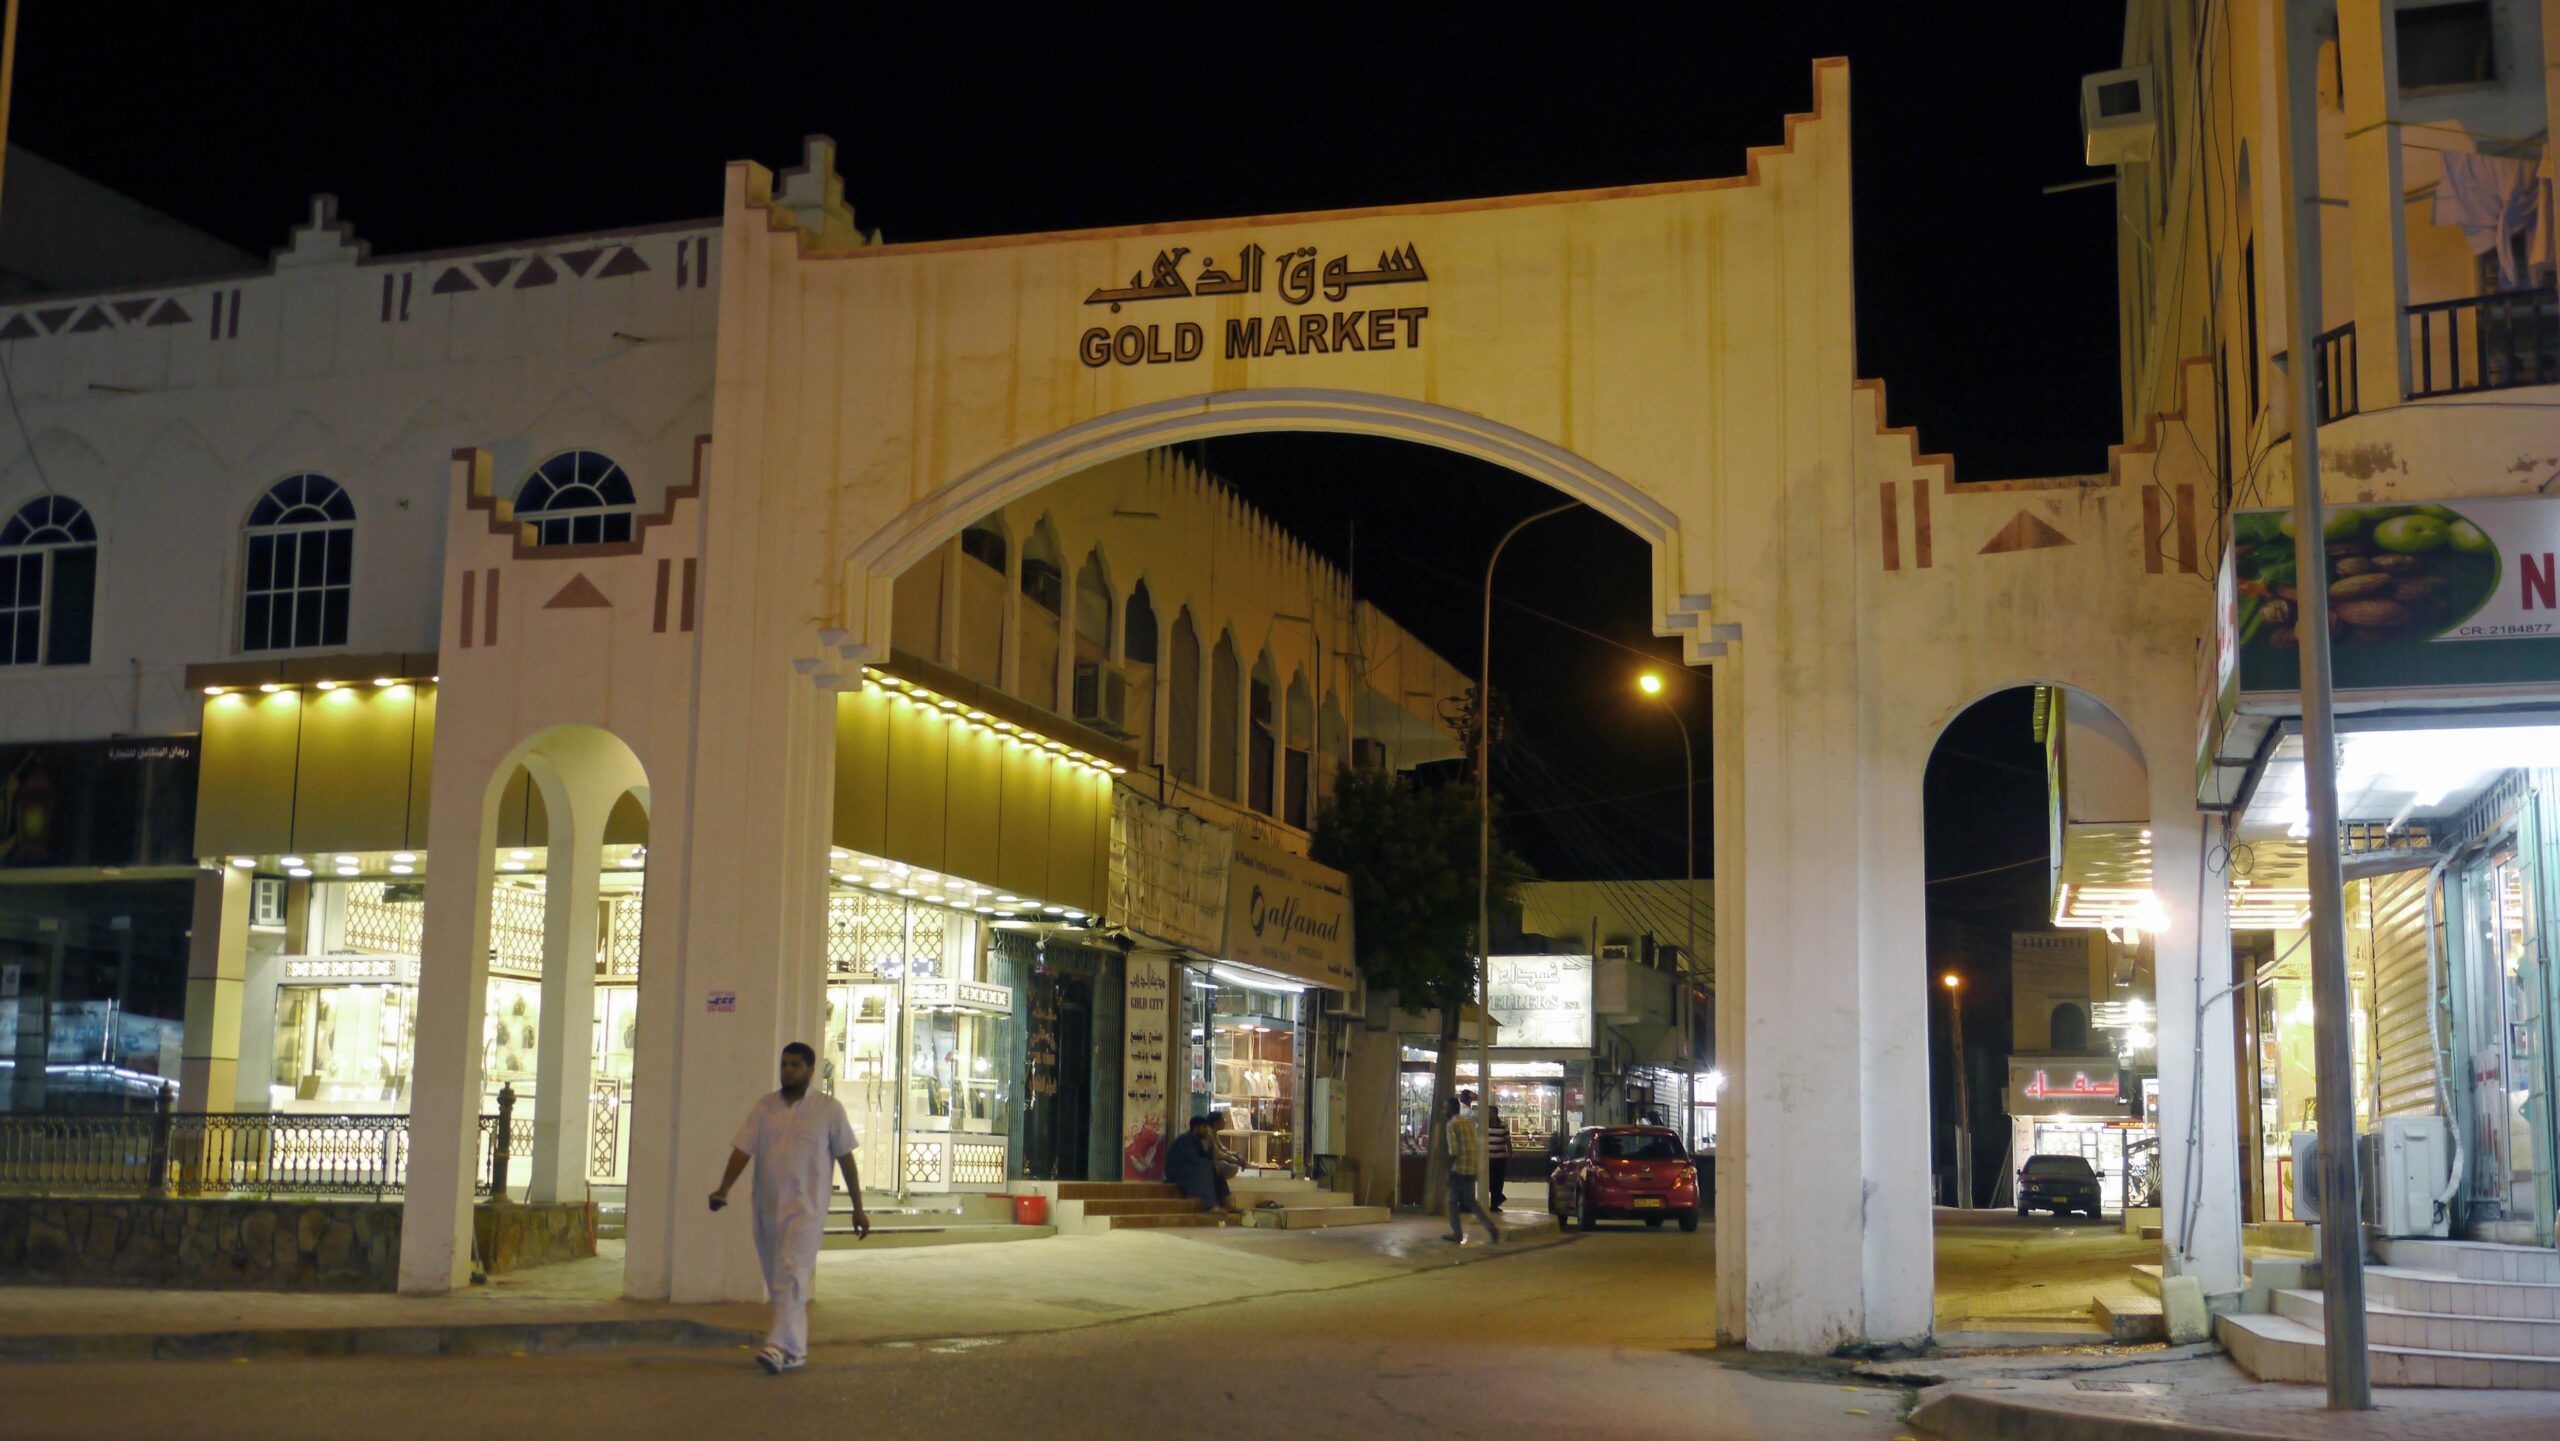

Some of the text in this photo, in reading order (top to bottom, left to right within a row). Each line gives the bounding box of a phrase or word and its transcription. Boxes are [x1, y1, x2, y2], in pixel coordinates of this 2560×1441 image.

[1083, 241, 1428, 313] سوق الذهب
[1080, 307, 1429, 368] GOLD MARKET
[2489, 623, 2552, 635] 2184877
[1268, 896, 1341, 942] alfanad
[1131, 996, 1165, 1011] GOLD CITY
